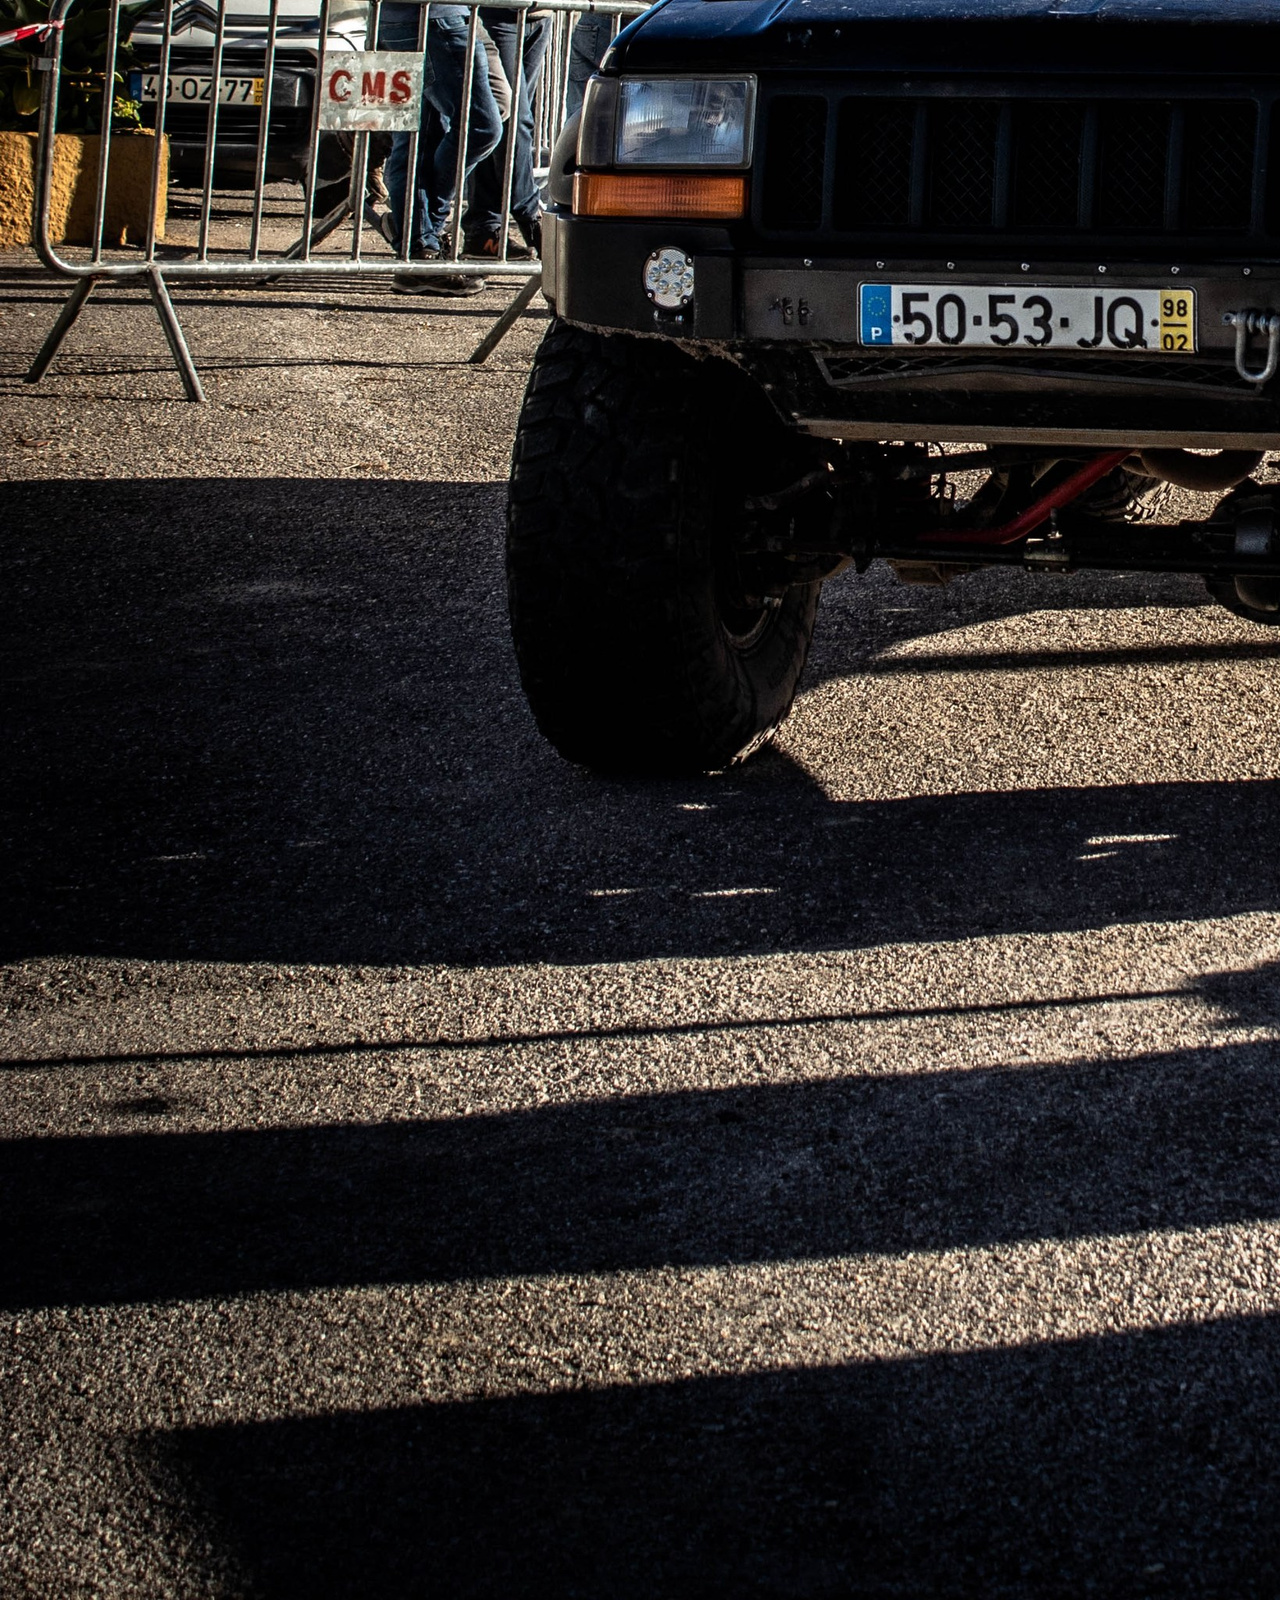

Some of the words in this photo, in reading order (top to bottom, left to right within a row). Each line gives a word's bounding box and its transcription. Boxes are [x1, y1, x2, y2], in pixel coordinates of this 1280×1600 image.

[328, 69, 412, 105] CMS
[1162, 298, 1188, 318] 98
[870, 326, 882, 342] P
[1162, 333, 1188, 352] 02
